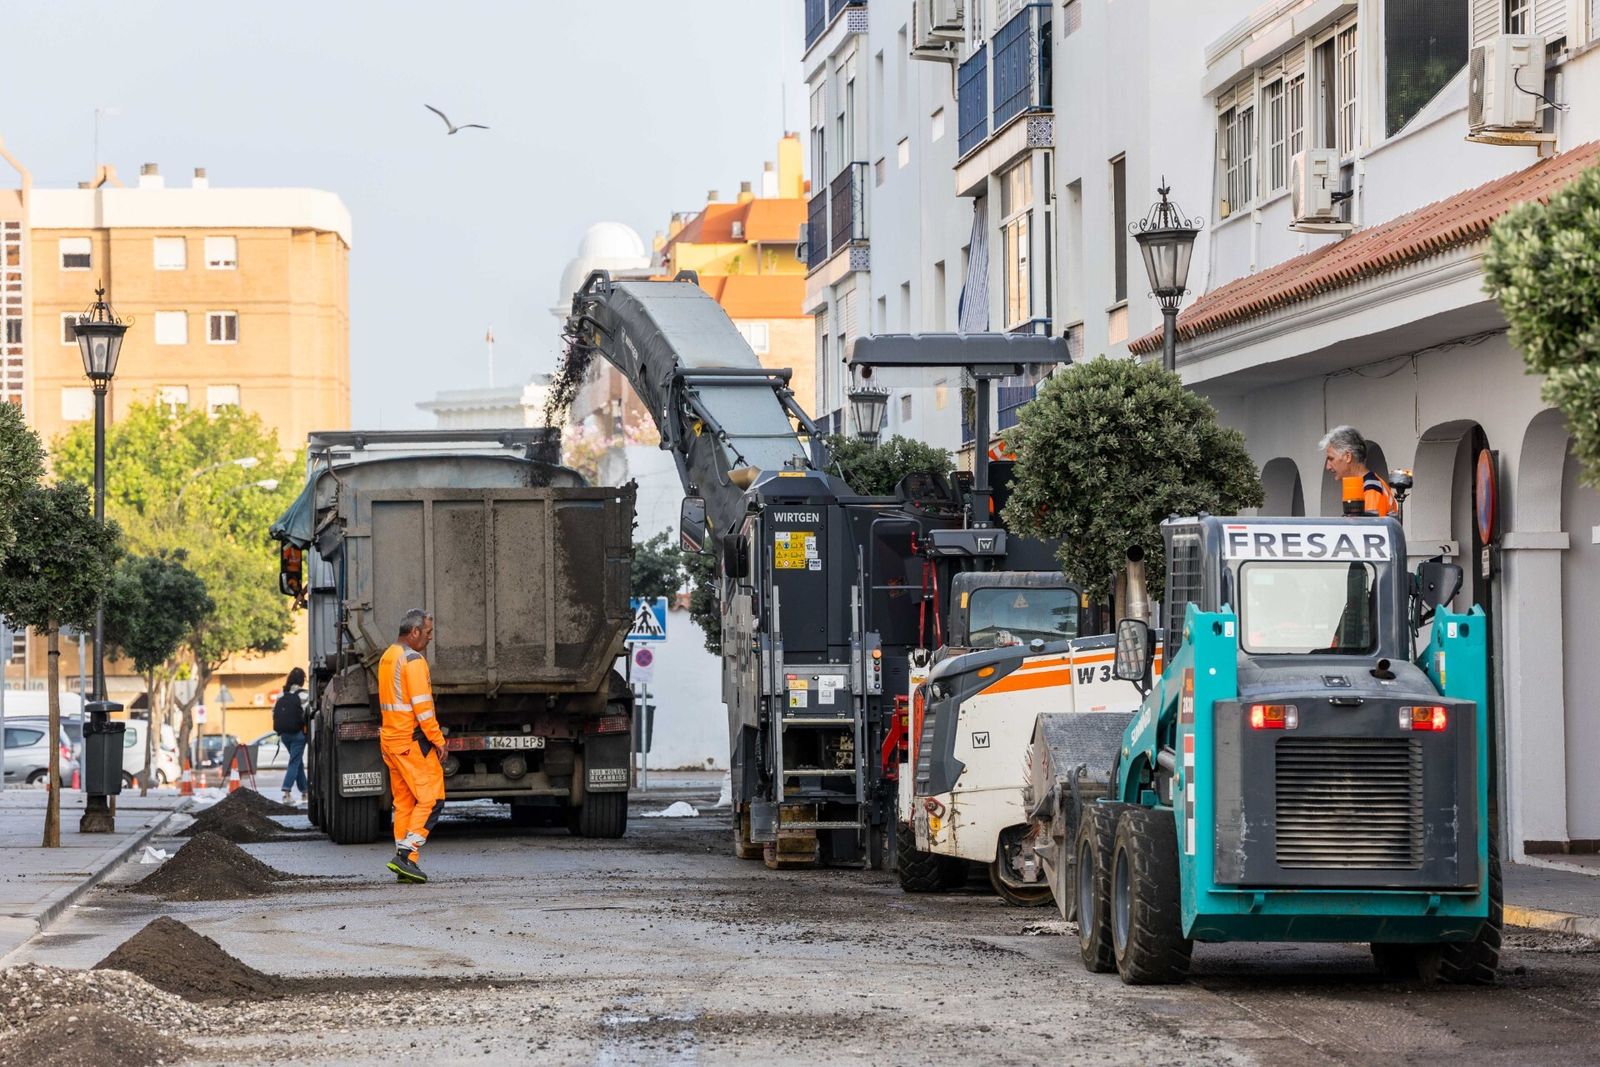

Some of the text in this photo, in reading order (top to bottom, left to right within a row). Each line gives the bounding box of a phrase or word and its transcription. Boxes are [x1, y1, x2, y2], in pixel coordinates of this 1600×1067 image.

[774, 512, 819, 523] WIRTGEN
[1228, 532, 1387, 559] FRESAR
[1077, 667, 1095, 684] W
[493, 737, 518, 748] 1421
[523, 737, 544, 748] LPS
